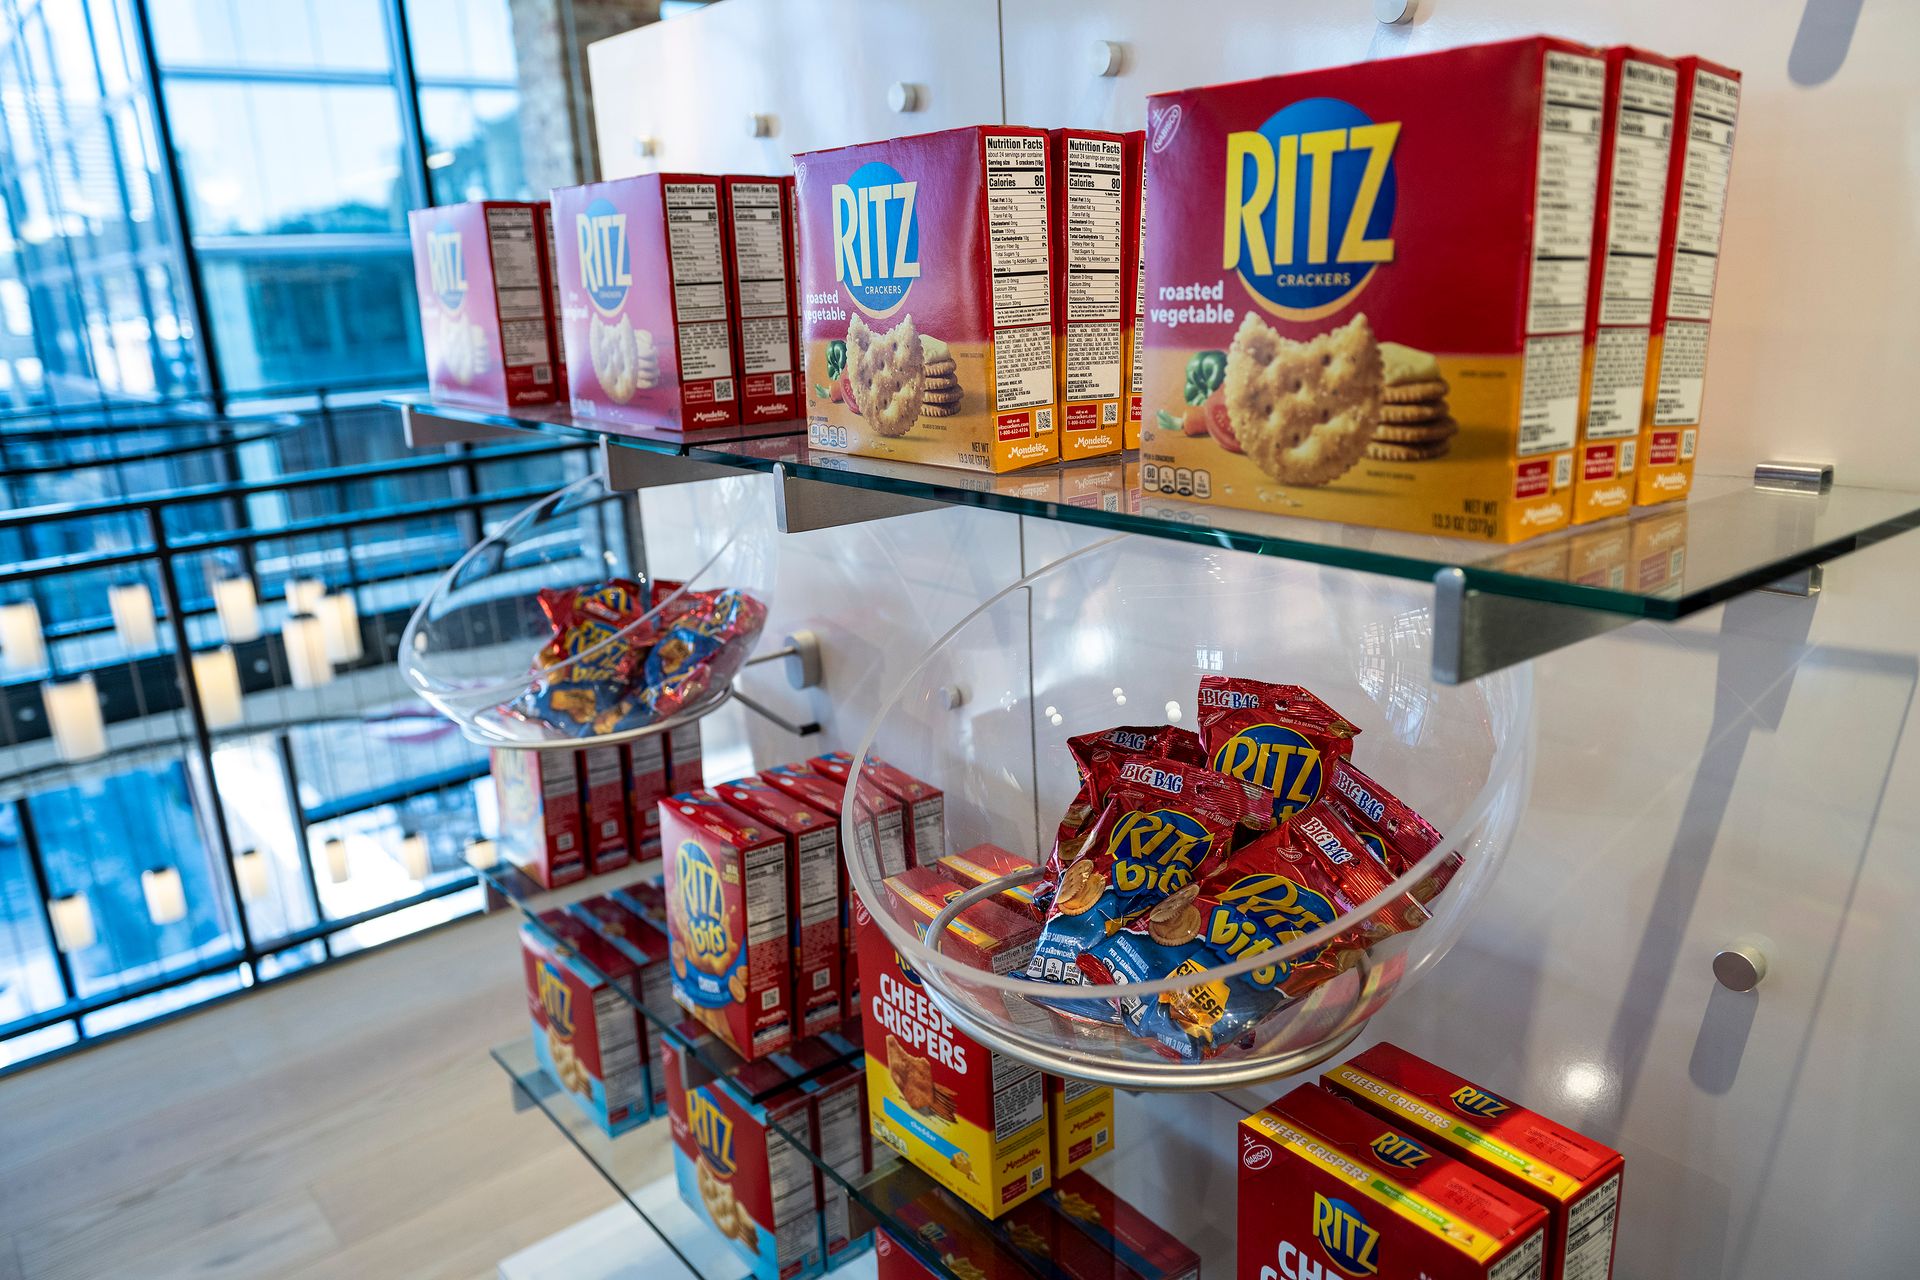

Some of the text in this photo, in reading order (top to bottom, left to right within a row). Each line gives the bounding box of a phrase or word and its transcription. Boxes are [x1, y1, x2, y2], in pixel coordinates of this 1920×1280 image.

[987, 138, 1043, 149] Nutrition Facts
[1154, 108, 1179, 149] NABISCO
[1069, 140, 1120, 154] Nutrition Facts
[761, 185, 778, 193] Facts
[989, 175, 1045, 187] Calories 80
[1069, 178, 1121, 189] Calories 80
[771, 211, 780, 219] 80
[1223, 121, 1402, 276] RITZ
[708, 212, 717, 220] 80
[832, 181, 921, 287] RITZ
[427, 231, 468, 294] RITZ
[576, 213, 632, 293] RITZ
[865, 286, 902, 294] CRACKERS
[1159, 280, 1224, 301] roasted
[1277, 272, 1351, 287] CRACKERS
[806, 290, 839, 304] roasted
[804, 307, 846, 323] vegetable
[1150, 304, 1235, 327] vegetable
[958, 453, 969, 463] 13.3
[971, 441, 989, 453] NET WT
[1008, 443, 1049, 459] Mondelēz
[1074, 435, 1112, 448] Mondelēz
[1463, 498, 1480, 513] NET
[1202, 688, 1260, 709] BIG BAG
[1115, 733, 1146, 751] BAG
[1121, 764, 1184, 793] BIG BAG
[1221, 736, 1320, 803] RITZ
[1337, 771, 1385, 823] BIG BAG
[1105, 811, 1216, 866] RITZ
[1279, 848, 1303, 861] NABISCO
[1300, 817, 1354, 866] BIG BAG
[678, 848, 720, 921] RITZ
[1116, 860, 1193, 893] bits
[1215, 876, 1328, 946] RIT
[690, 920, 725, 955] bits
[994, 942, 1037, 964] Nutrition Fact
[1211, 909, 1287, 985] bits
[1108, 947, 1117, 958] PER
[1120, 959, 1142, 984] SANDWICHE
[1117, 936, 1149, 974] CRACKER SANDWICHES
[535, 958, 576, 1035] RITZ
[880, 973, 954, 1039] CHEESE
[1176, 963, 1224, 1019] CEESE
[872, 995, 968, 1075] CRISPERS
[1340, 1070, 1452, 1129] CHEESE CRISPERS
[1449, 1085, 1512, 1118] RITZ
[685, 1088, 738, 1173] RITZ
[1245, 1148, 1270, 1166] NABISCO
[1259, 1116, 1371, 1182] CHEESE CRISPERS
[1370, 1131, 1432, 1169] RITZ
[1571, 1177, 1618, 1217] Nutrition Facts
[1313, 1191, 1380, 1275] RITZ
[1603, 1209, 1616, 1226] 140
[1490, 1234, 1542, 1279] Nutrition Facts
[1567, 1232, 1591, 1252] Calories
